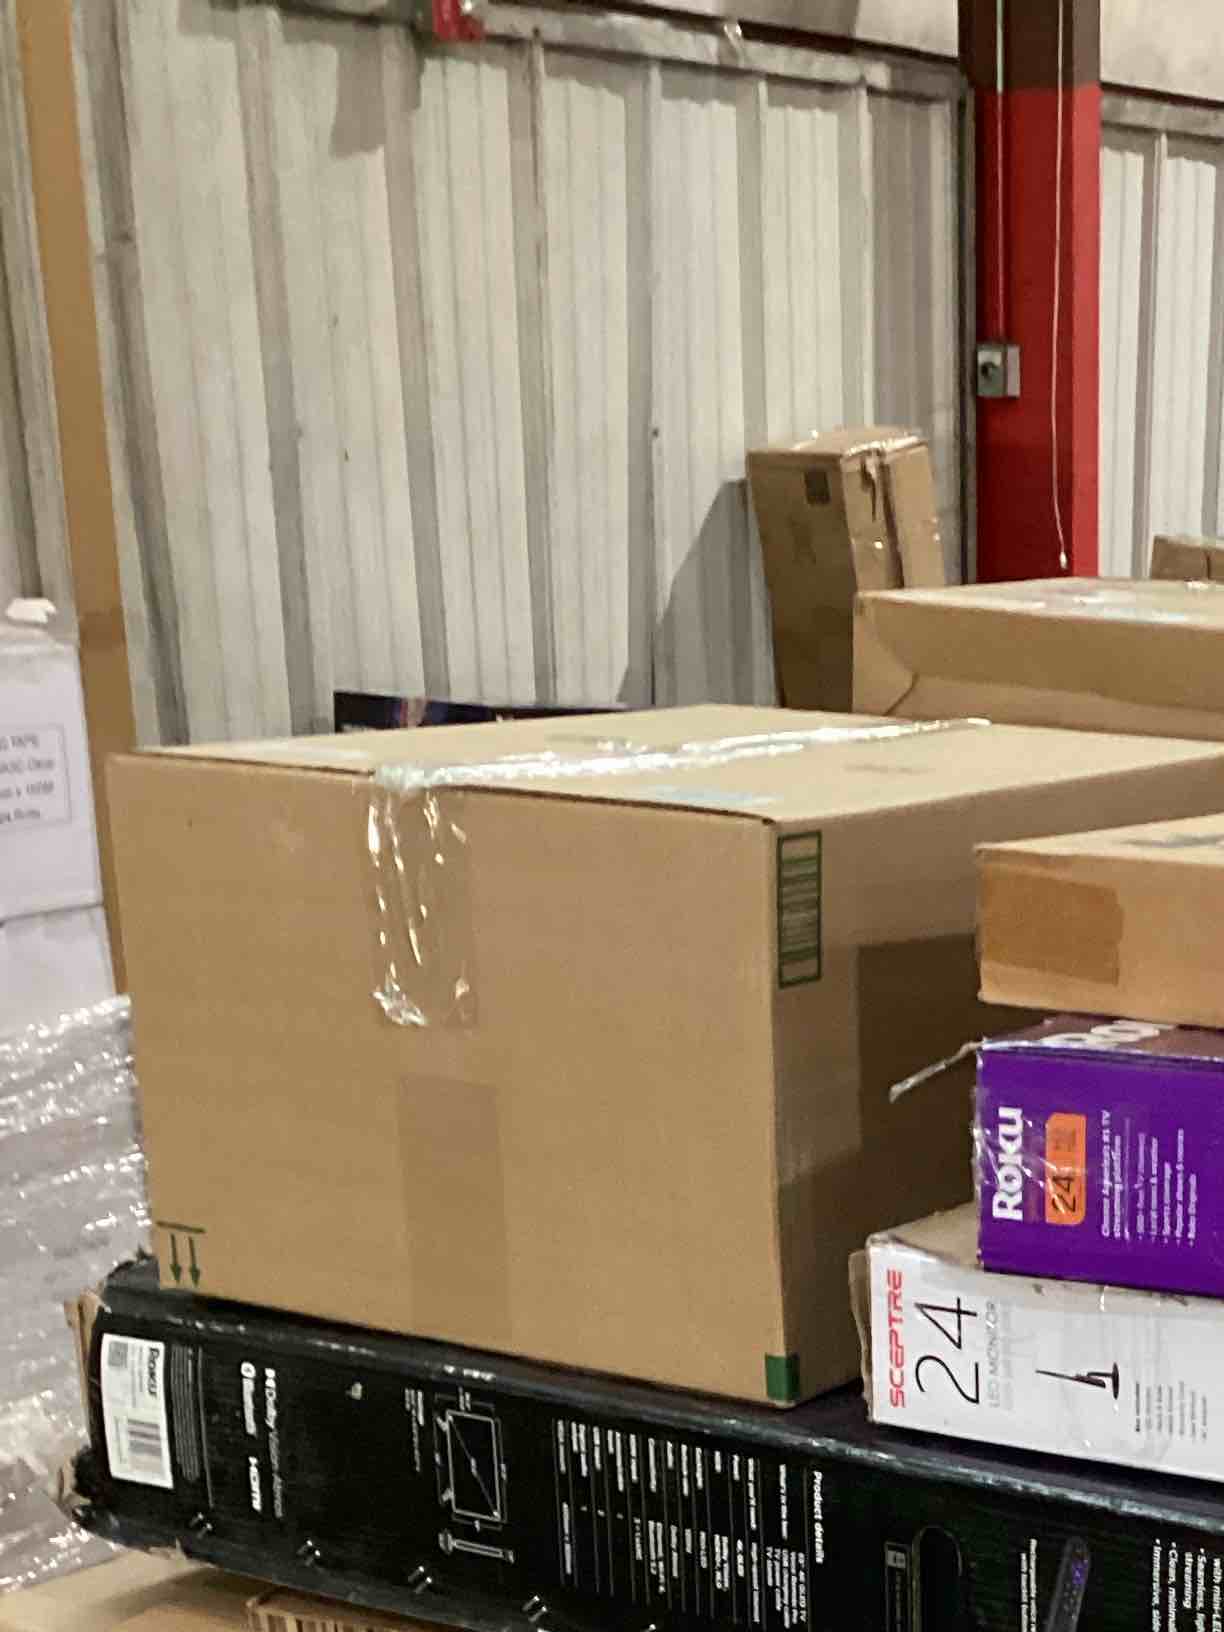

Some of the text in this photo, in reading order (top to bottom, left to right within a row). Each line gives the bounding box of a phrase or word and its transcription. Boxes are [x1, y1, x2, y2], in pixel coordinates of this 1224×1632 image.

[992, 1107, 1023, 1222] Roku
[1051, 1175, 1076, 1213] 24
[887, 1269, 905, 1409] SCEPTRE
[913, 1297, 980, 1406] 24
[146, 1346, 161, 1399] Roku
[812, 1470, 825, 1564] Product details
[1166, 1549, 1178, 1585] Clean,
[1182, 1552, 1194, 1609] streaming
[1212, 1558, 1222, 1584] with
